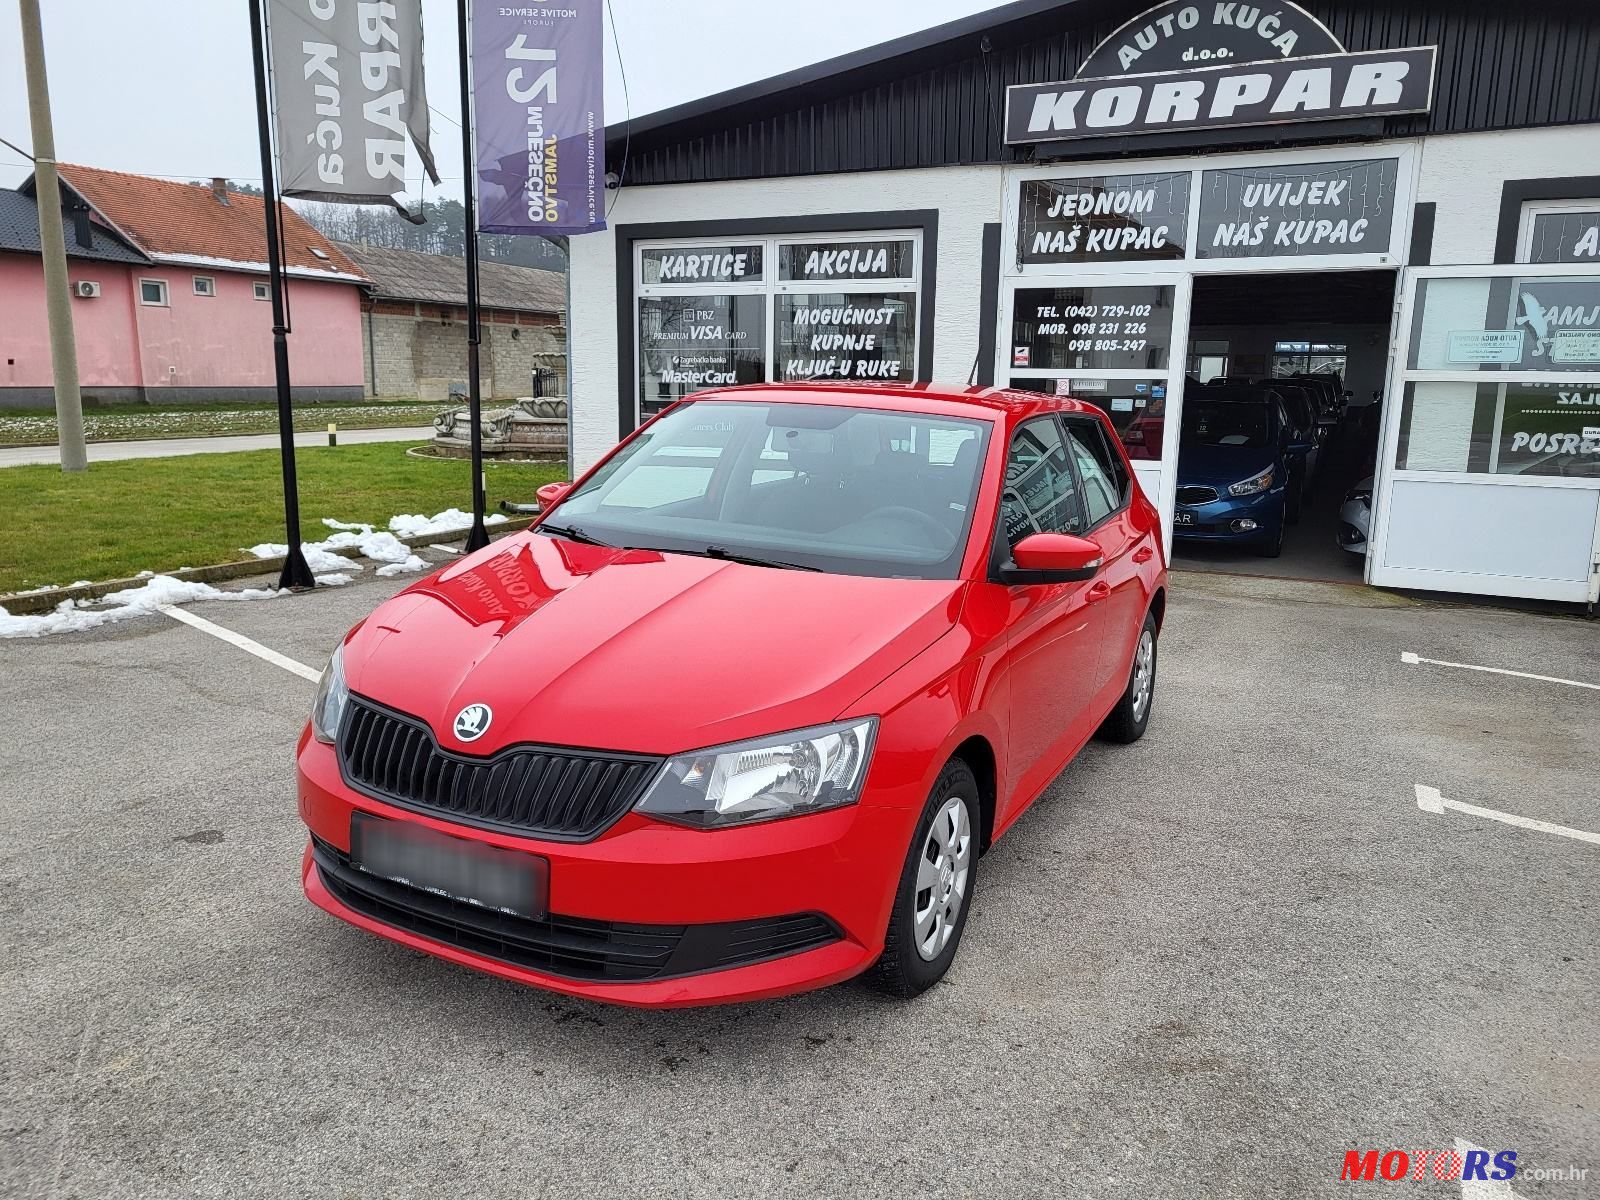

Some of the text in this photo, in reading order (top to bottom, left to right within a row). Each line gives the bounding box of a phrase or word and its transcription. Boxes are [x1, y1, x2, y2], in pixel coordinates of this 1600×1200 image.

[1116, 2, 1300, 71] AUTO KUĆA
[1181, 47, 1234, 63] d.o.o.
[1027, 60, 1410, 133] KORPAR
[1047, 189, 1155, 219] JEDNOM
[1242, 179, 1348, 208] UVIJEK
[1032, 225, 1169, 254] NAŠ KUPAC
[1212, 215, 1369, 247] NAŠ KUPAC
[659, 253, 749, 279] KARTICE
[804, 248, 888, 275] AKCIJA
[696, 310, 715, 321] PBZ
[793, 304, 896, 326] MOGUĆNOST
[1036, 304, 1151, 318] TEL. (042) 729-102
[653, 325, 747, 341] PREMIUM VISA CARD
[1037, 322, 1147, 335] MOB. 098 231 226
[810, 334, 876, 351] KUPNJE
[1068, 339, 1146, 352] 098 805-247
[709, 355, 727, 365] banka
[786, 355, 900, 378] KLJUČ U RUKE
